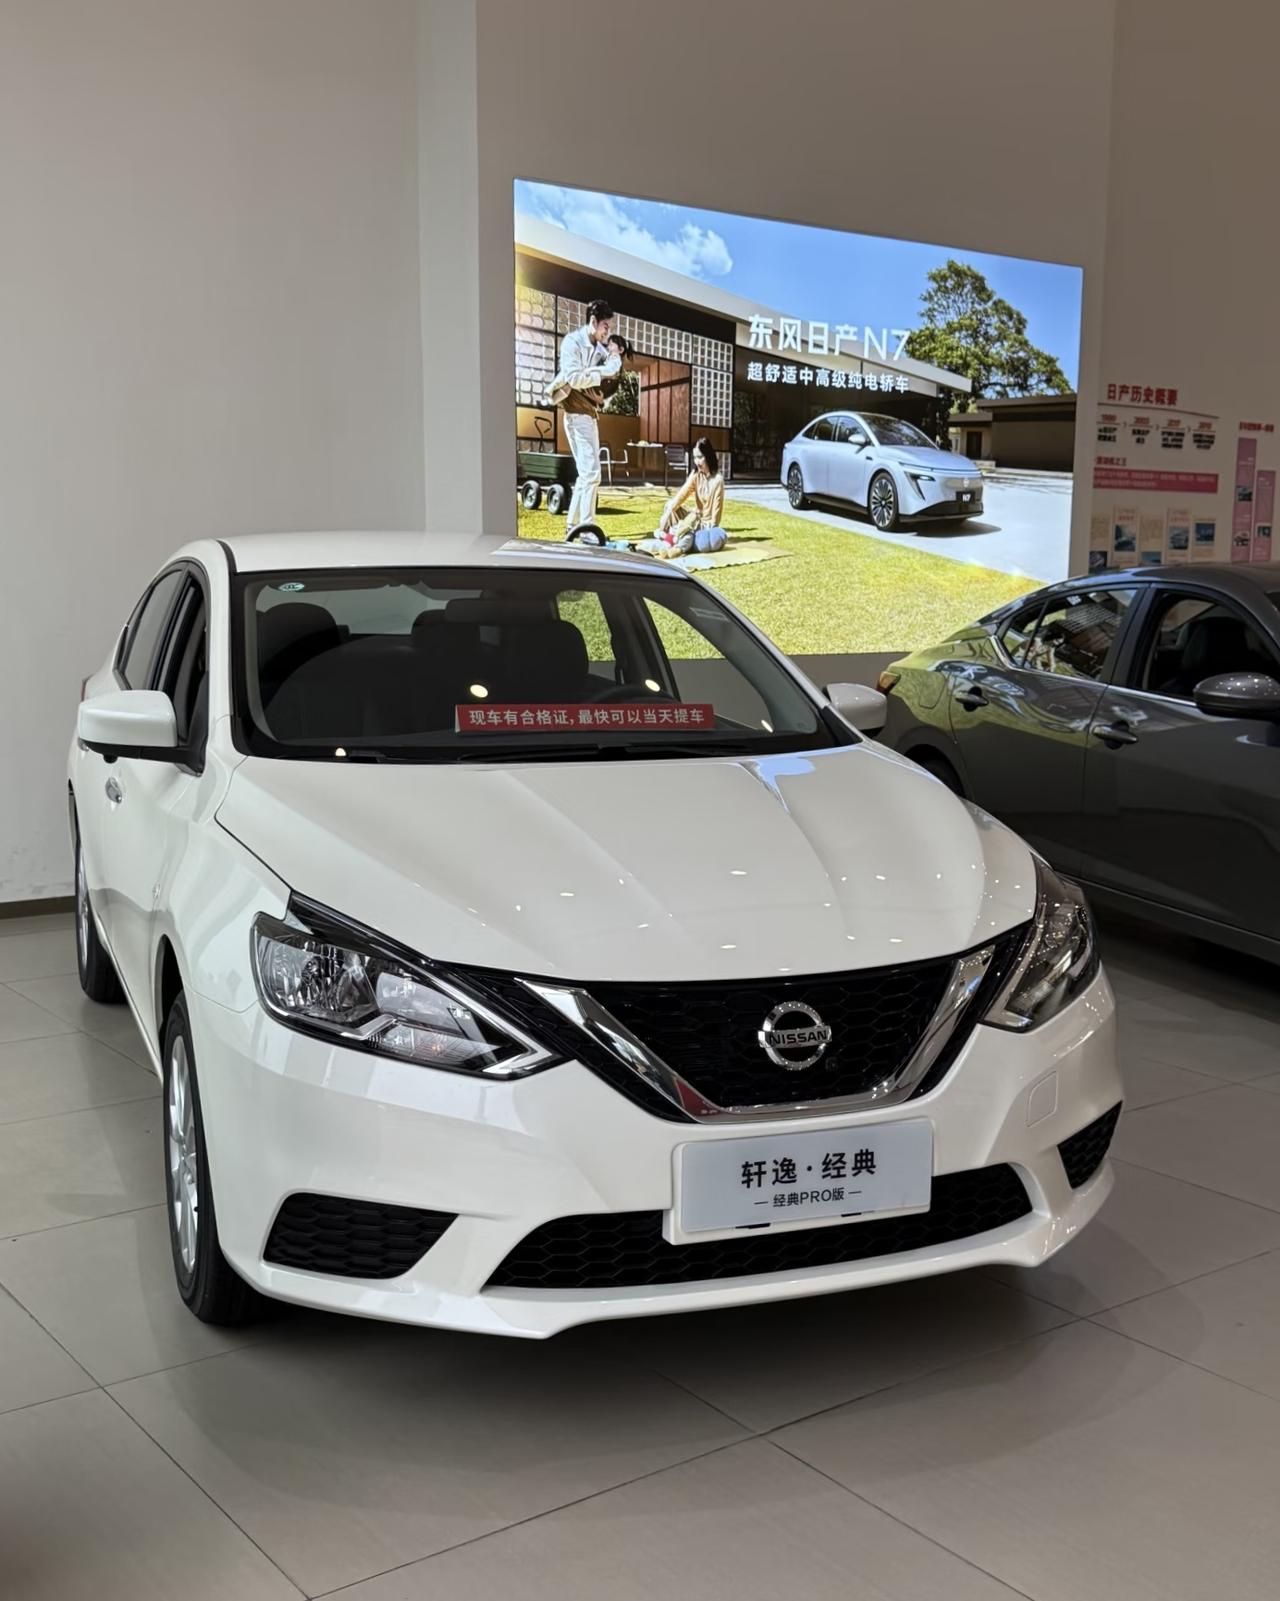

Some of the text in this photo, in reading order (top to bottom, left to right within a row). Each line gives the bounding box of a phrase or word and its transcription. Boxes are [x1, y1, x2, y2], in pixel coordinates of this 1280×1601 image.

[748, 314, 911, 361] 东风日产N7
[747, 361, 909, 394] 超舒适中高级纯电轿车
[469, 708, 705, 726] 现车有合格证，最快可以当天提车
[770, 1030, 827, 1045] NISSAN
[741, 1148, 876, 1188] 轩逸·经典
[773, 1187, 844, 1207] 经典PRO版
